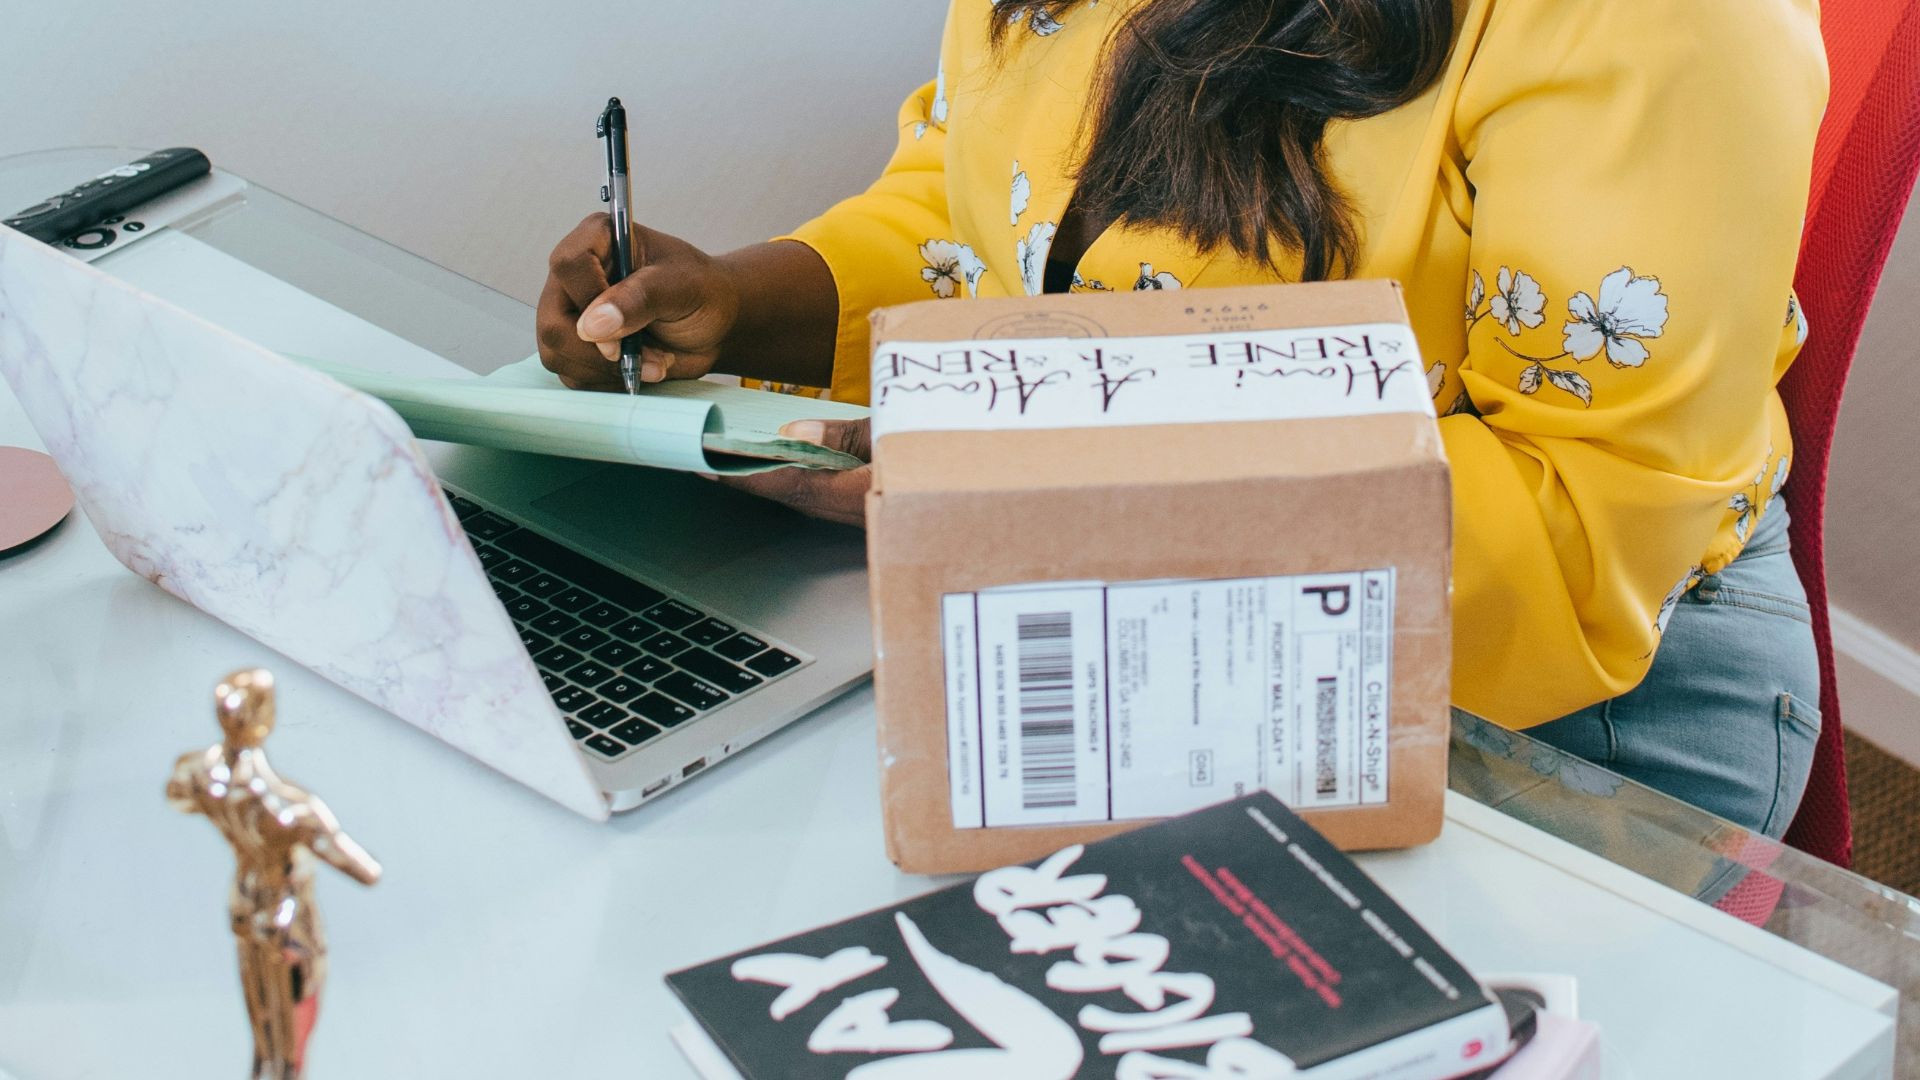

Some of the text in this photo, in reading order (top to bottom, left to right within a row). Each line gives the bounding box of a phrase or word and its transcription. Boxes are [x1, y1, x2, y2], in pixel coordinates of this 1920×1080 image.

[1187, 335, 1375, 369] RENEE
[1236, 360, 1417, 400] Alani
[1302, 584, 1351, 616] P
[738, 635, 761, 647] control
[1272, 622, 1283, 679] PRIORITY
[1272, 683, 1283, 713] MAIL
[1088, 693, 1098, 744] TRACKING
